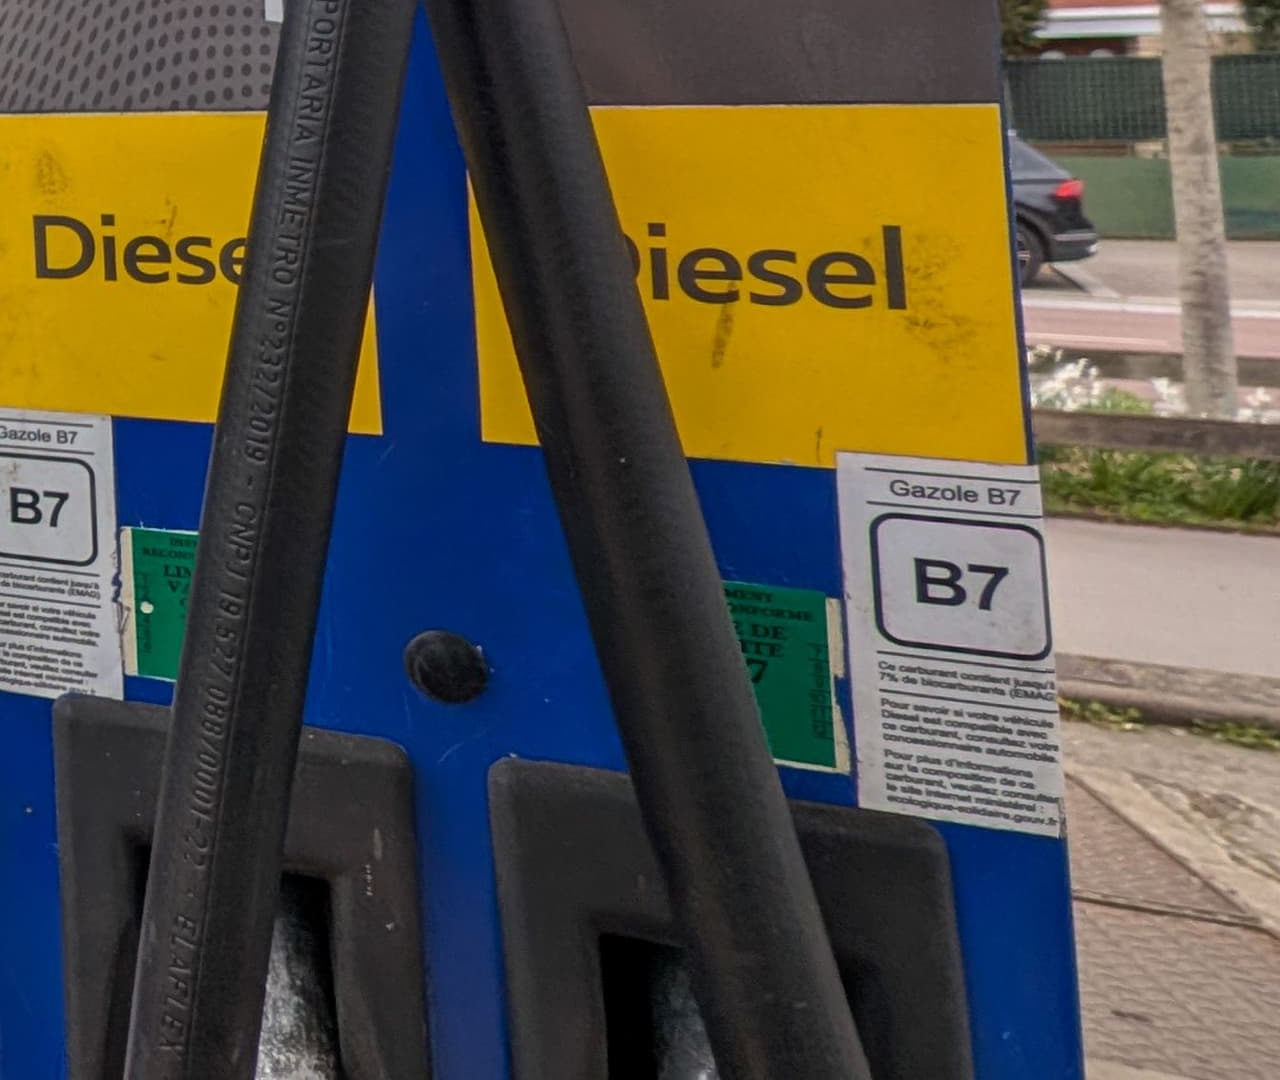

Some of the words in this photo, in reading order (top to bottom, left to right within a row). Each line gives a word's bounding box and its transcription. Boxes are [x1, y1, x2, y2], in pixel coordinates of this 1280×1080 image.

[271, 156, 314, 287] INMETRO
[32, 214, 248, 286] Diese
[632, 222, 907, 311] iesel
[56, 430, 78, 445] B7
[9, 487, 69, 528] B7
[889, 479, 979, 504] Gazole
[988, 488, 1021, 506] B7
[914, 557, 1009, 611] B7
